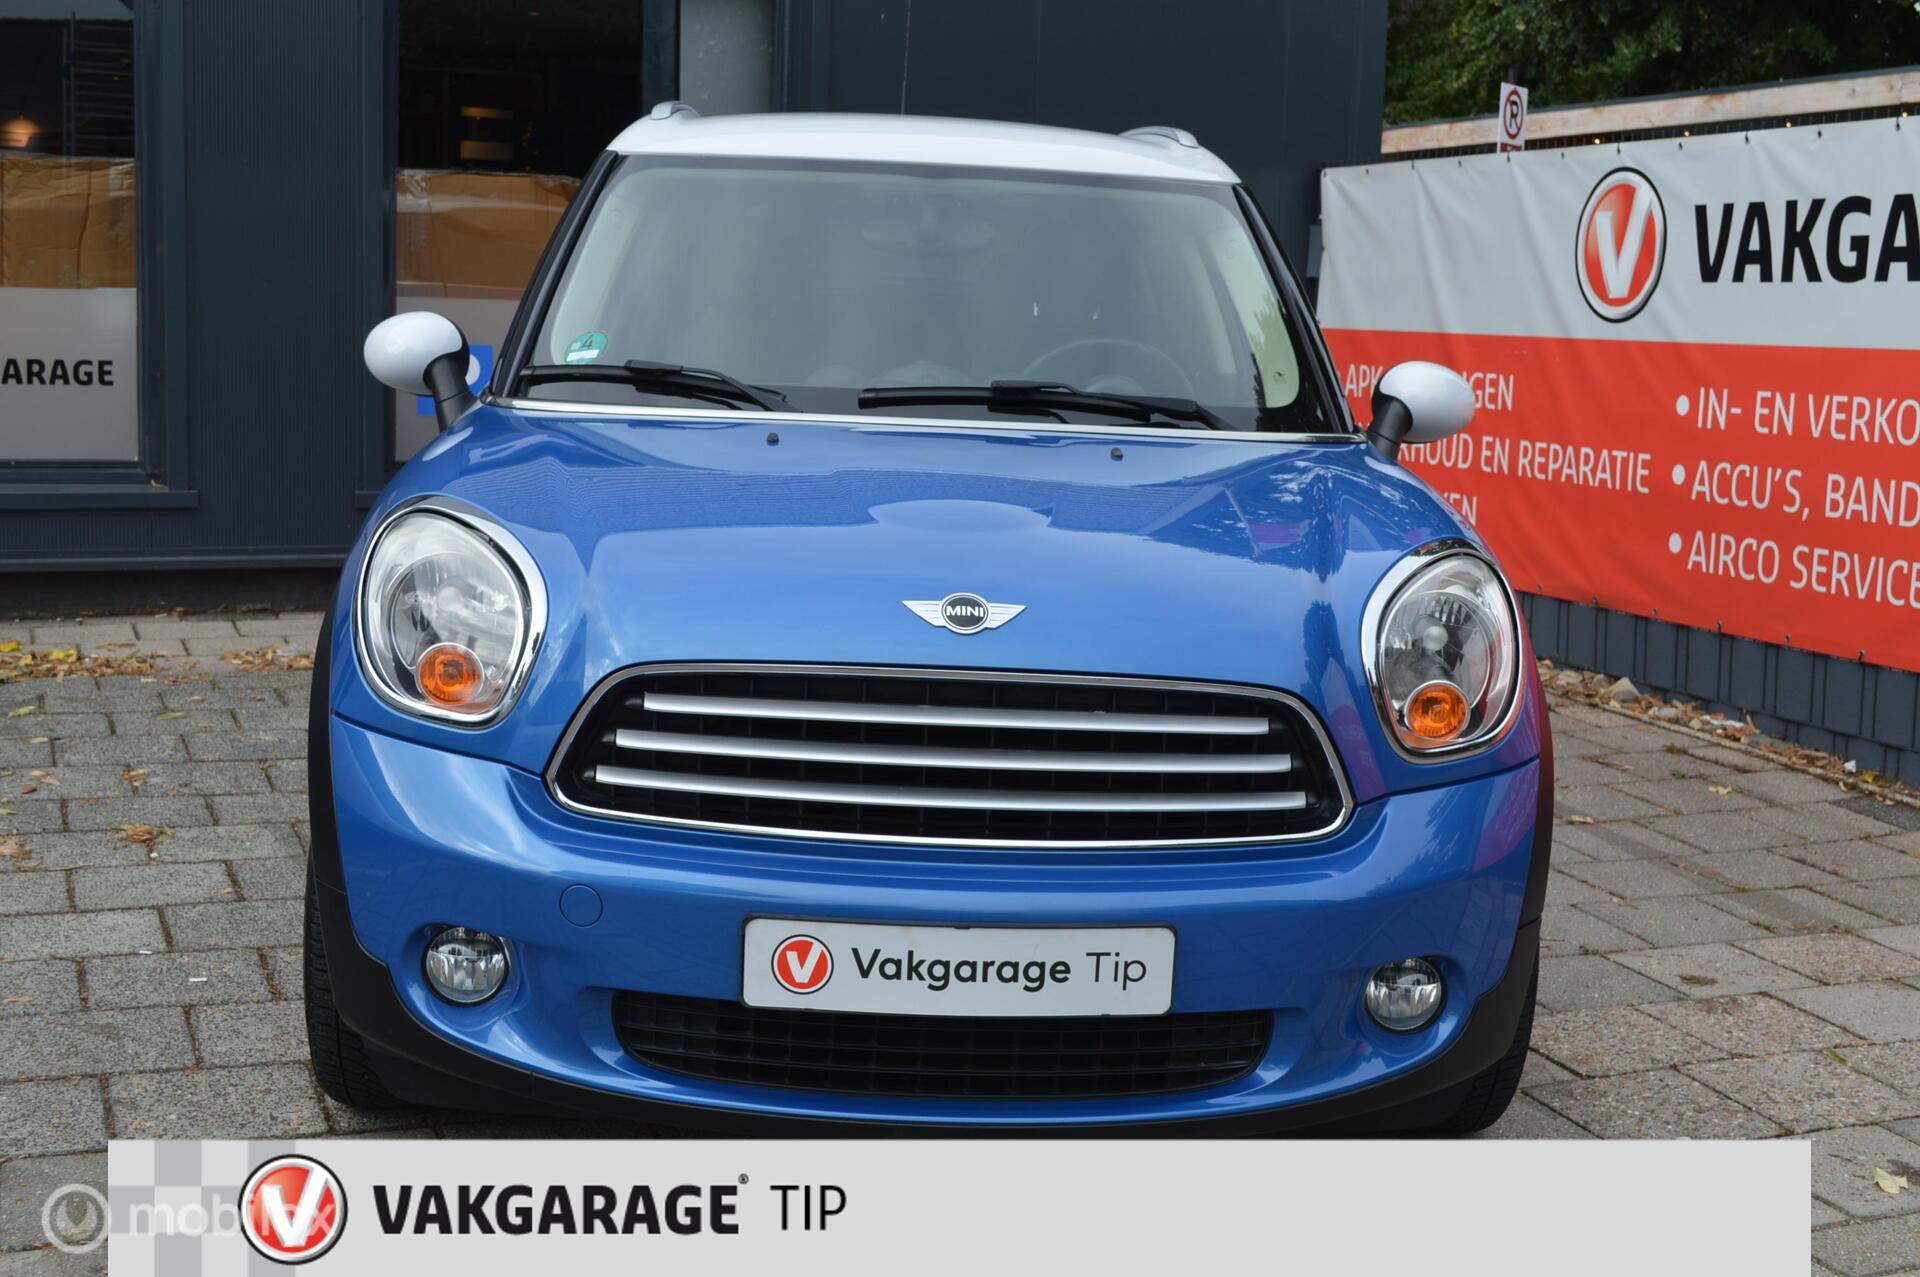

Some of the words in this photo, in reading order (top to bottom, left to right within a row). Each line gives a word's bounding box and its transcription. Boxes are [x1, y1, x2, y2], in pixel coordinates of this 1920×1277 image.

[1694, 193, 1920, 284] VAKGA
[1, 358, 115, 386] ARAGE
[1697, 387, 1742, 431] IN-
[1754, 390, 1796, 436] EN
[1808, 393, 1920, 446] VERKO
[1480, 435, 1510, 475] EN
[1517, 440, 1651, 494] REPARATIE
[1691, 460, 1810, 522] ACCU'S,
[1824, 473, 1920, 528] BAND
[1687, 530, 1780, 584] AIRCO
[1790, 545, 1920, 610] SERVICE
[945, 605, 984, 618] MINI
[851, 947, 1071, 993] Vakgarage
[1085, 951, 1147, 991] Tip
